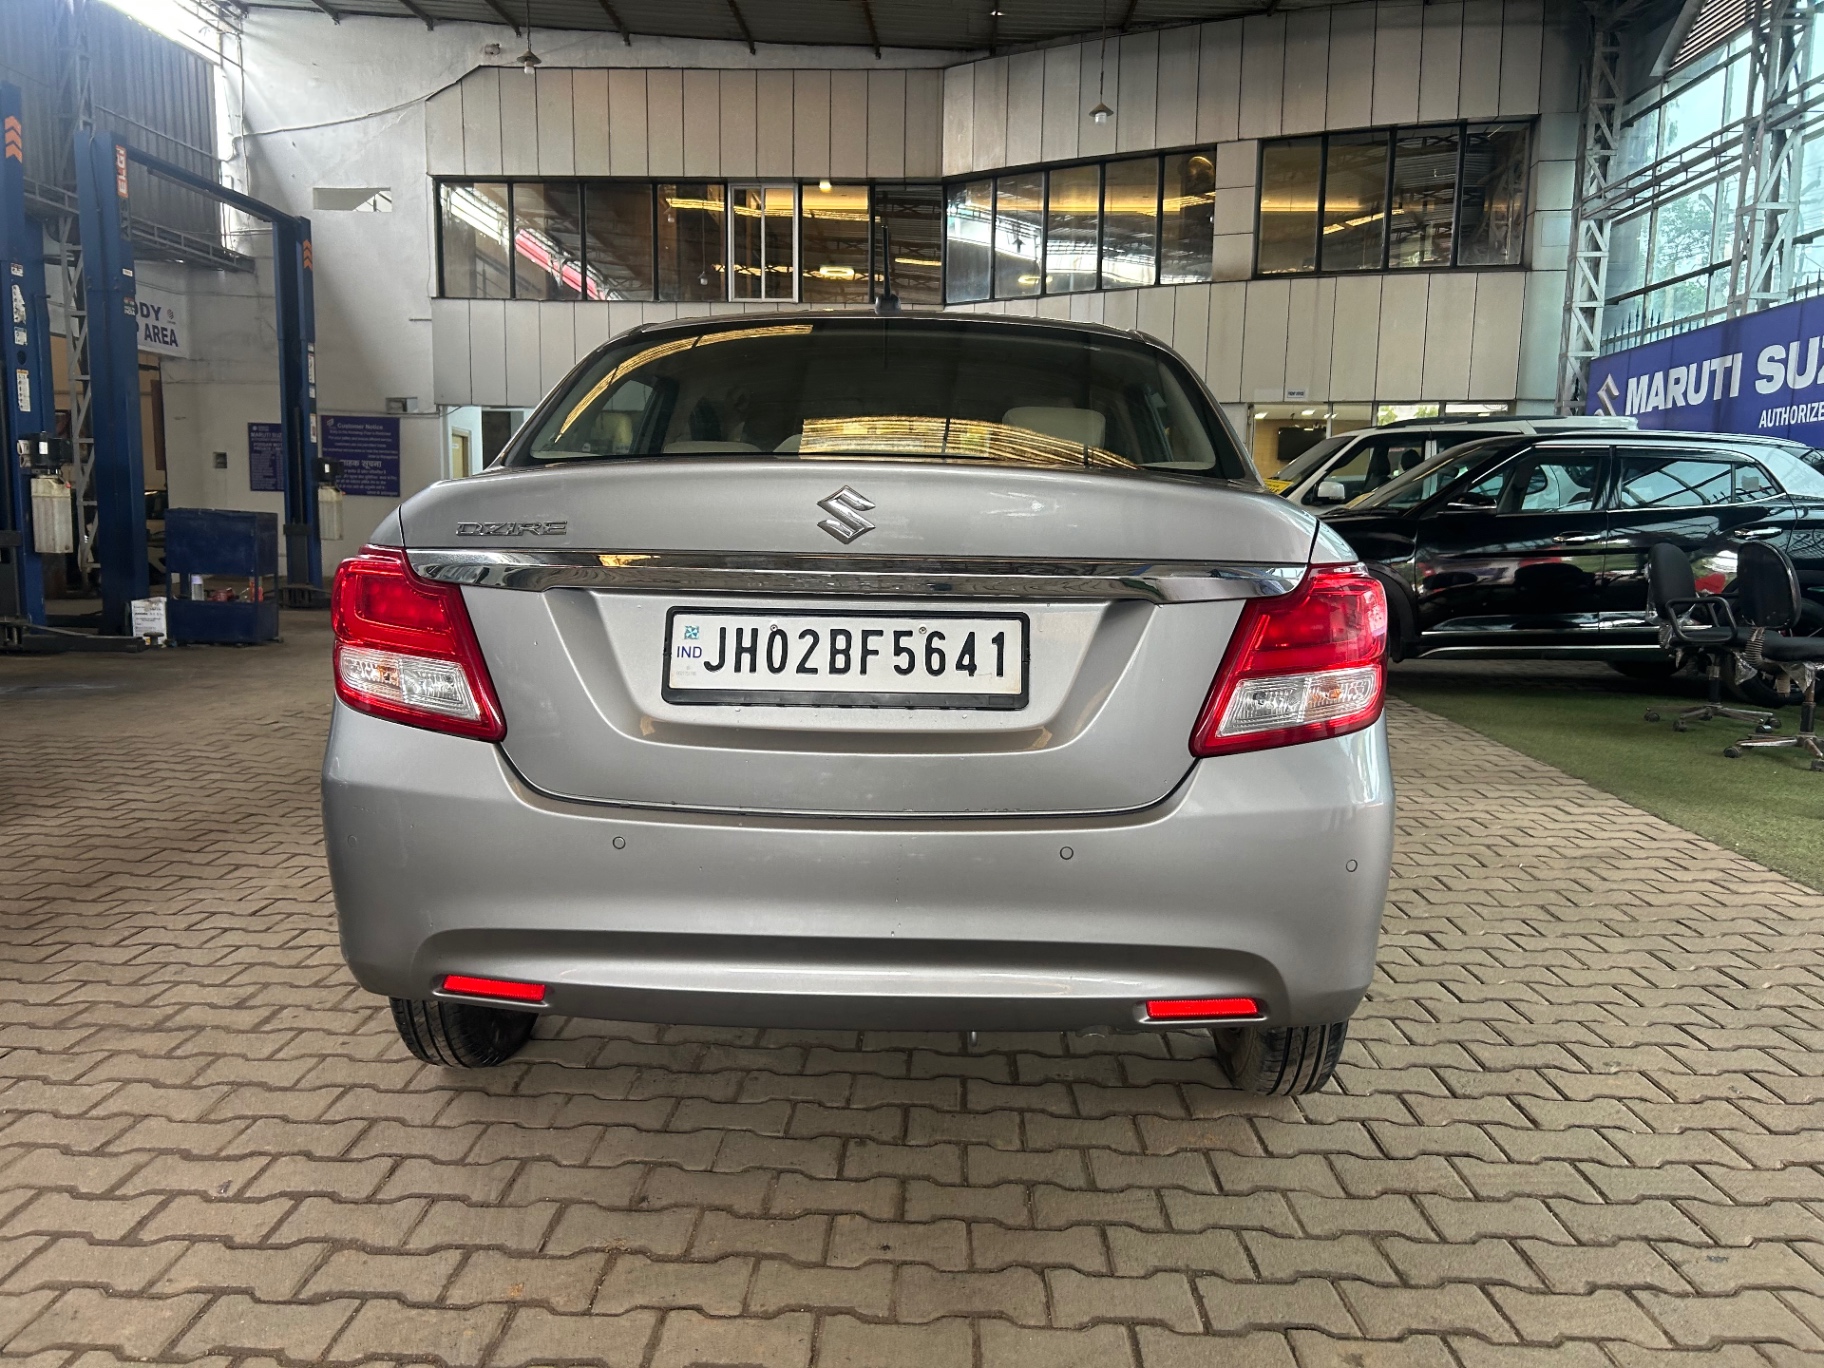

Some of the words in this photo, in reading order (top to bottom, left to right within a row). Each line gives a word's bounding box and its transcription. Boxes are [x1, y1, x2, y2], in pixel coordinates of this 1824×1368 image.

[116, 147, 127, 195] ELGI
[144, 323, 178, 347] AREA
[1625, 353, 1742, 415] MARUTI
[1755, 335, 1824, 394] SU
[455, 521, 568, 537] DZIRE
[676, 645, 702, 659] IND
[703, 626, 1006, 678] JH02BF5641
